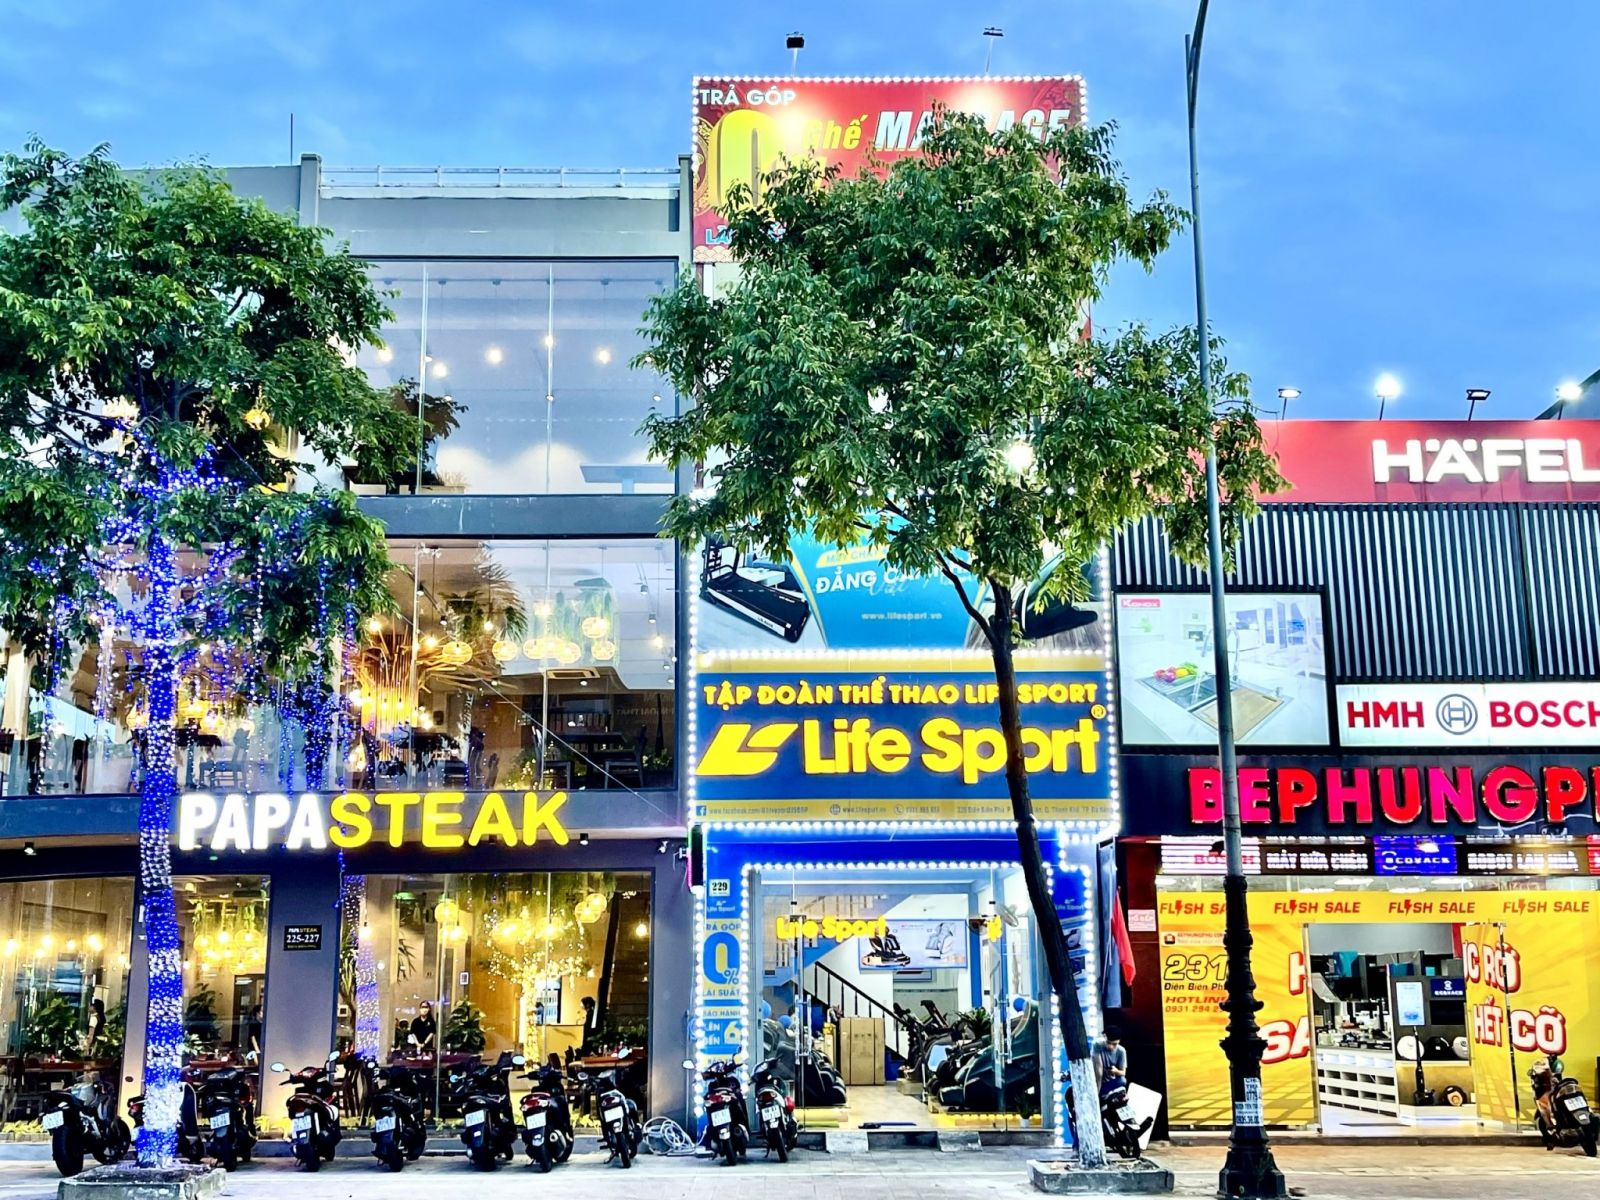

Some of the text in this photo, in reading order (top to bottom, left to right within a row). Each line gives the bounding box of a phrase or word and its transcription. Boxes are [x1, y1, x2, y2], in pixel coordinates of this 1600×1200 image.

[700, 84, 796, 106] TRẢ GÓP
[874, 109, 1069, 152] MAAGE
[703, 675, 1098, 711] TẬP ĐOÀN THỂ THAO LIF SPORT
[1348, 701, 1424, 727] HMH
[803, 718, 912, 775] Life
[1187, 765, 1600, 825] BEPHUNGP
[1193, 855, 1255, 864] BOSH
[711, 881, 728, 891] 229
[1209, 903, 1226, 915] SA
[1324, 902, 1361, 914] SALE
[1439, 902, 1476, 914] SALE
[1552, 901, 1590, 913] SALE
[287, 934, 320, 943] 225-227
[1211, 982, 1225, 991] Ph
[1474, 994, 1504, 1048] HẾT
